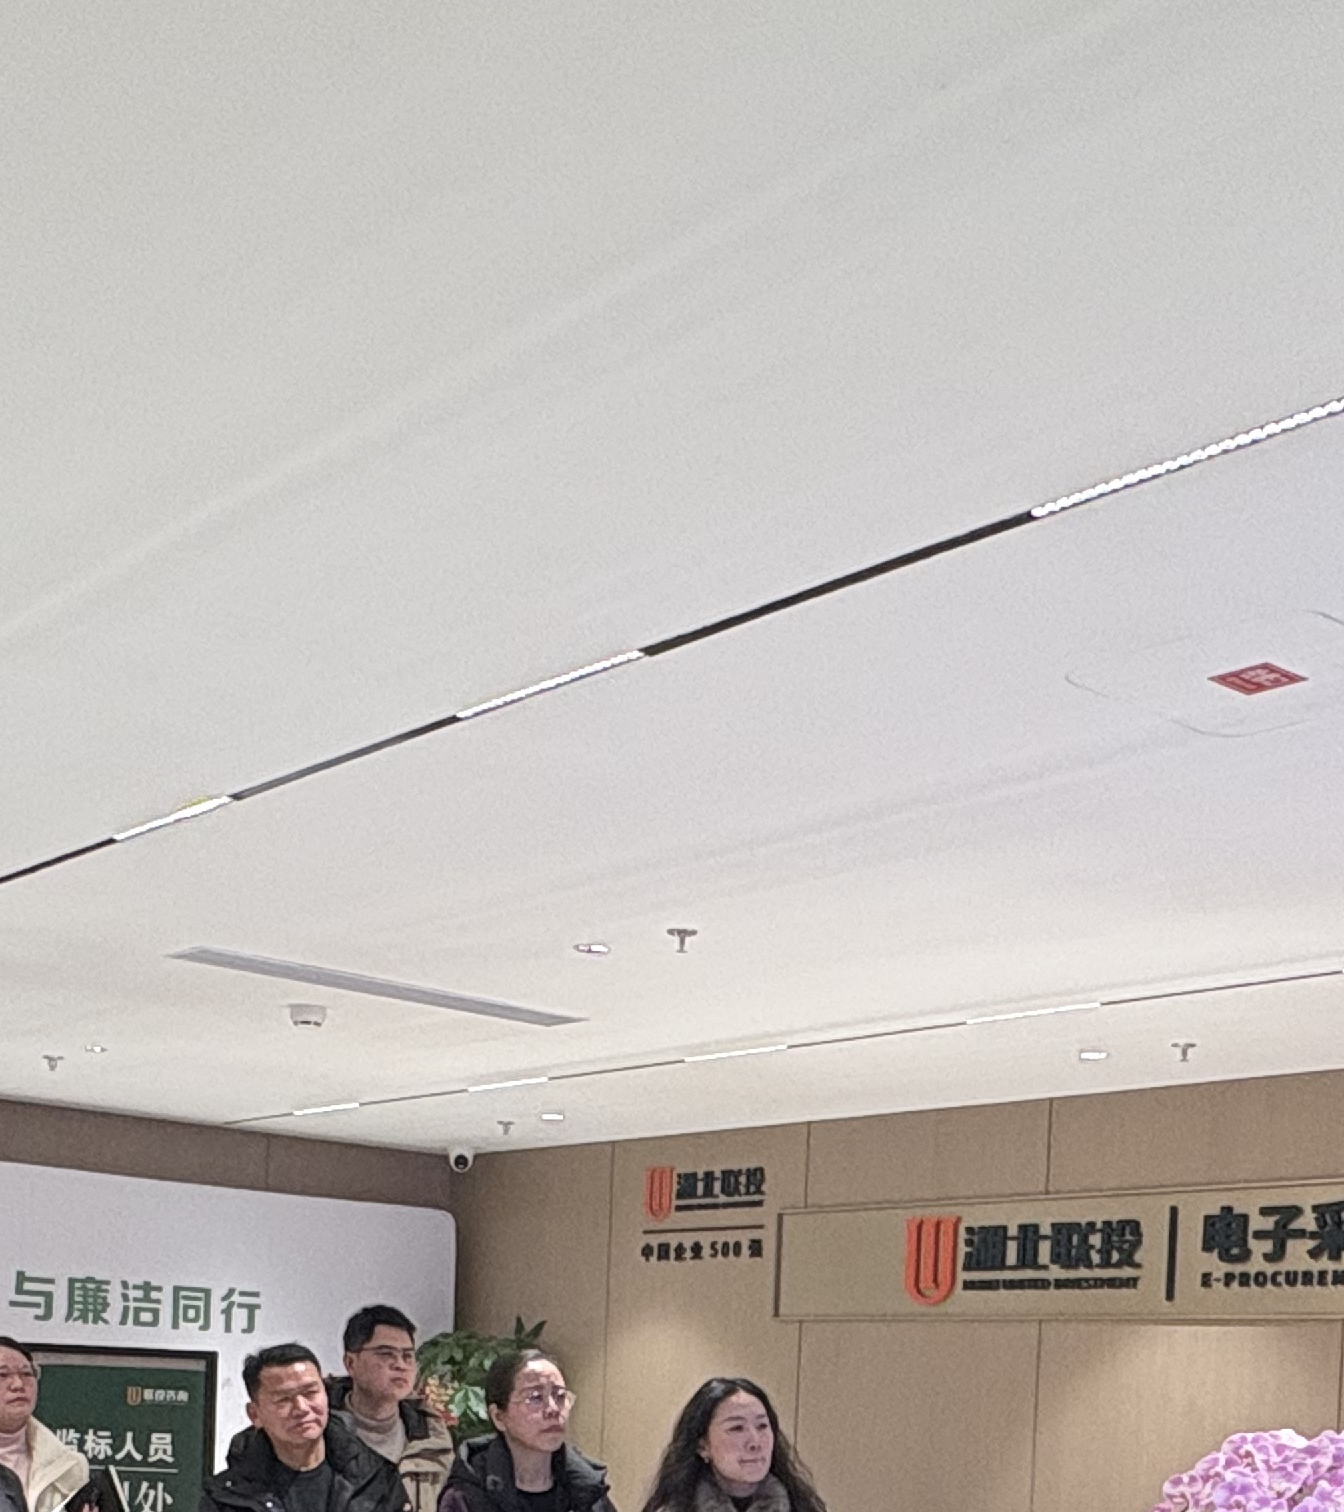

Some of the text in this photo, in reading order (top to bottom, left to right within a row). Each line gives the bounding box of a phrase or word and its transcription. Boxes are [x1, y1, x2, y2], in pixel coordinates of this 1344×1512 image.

[676, 1166, 766, 1200] 湖北联投
[962, 1218, 1144, 1271] 湖北联投
[8, 1269, 263, 1335] 与廉洁同行
